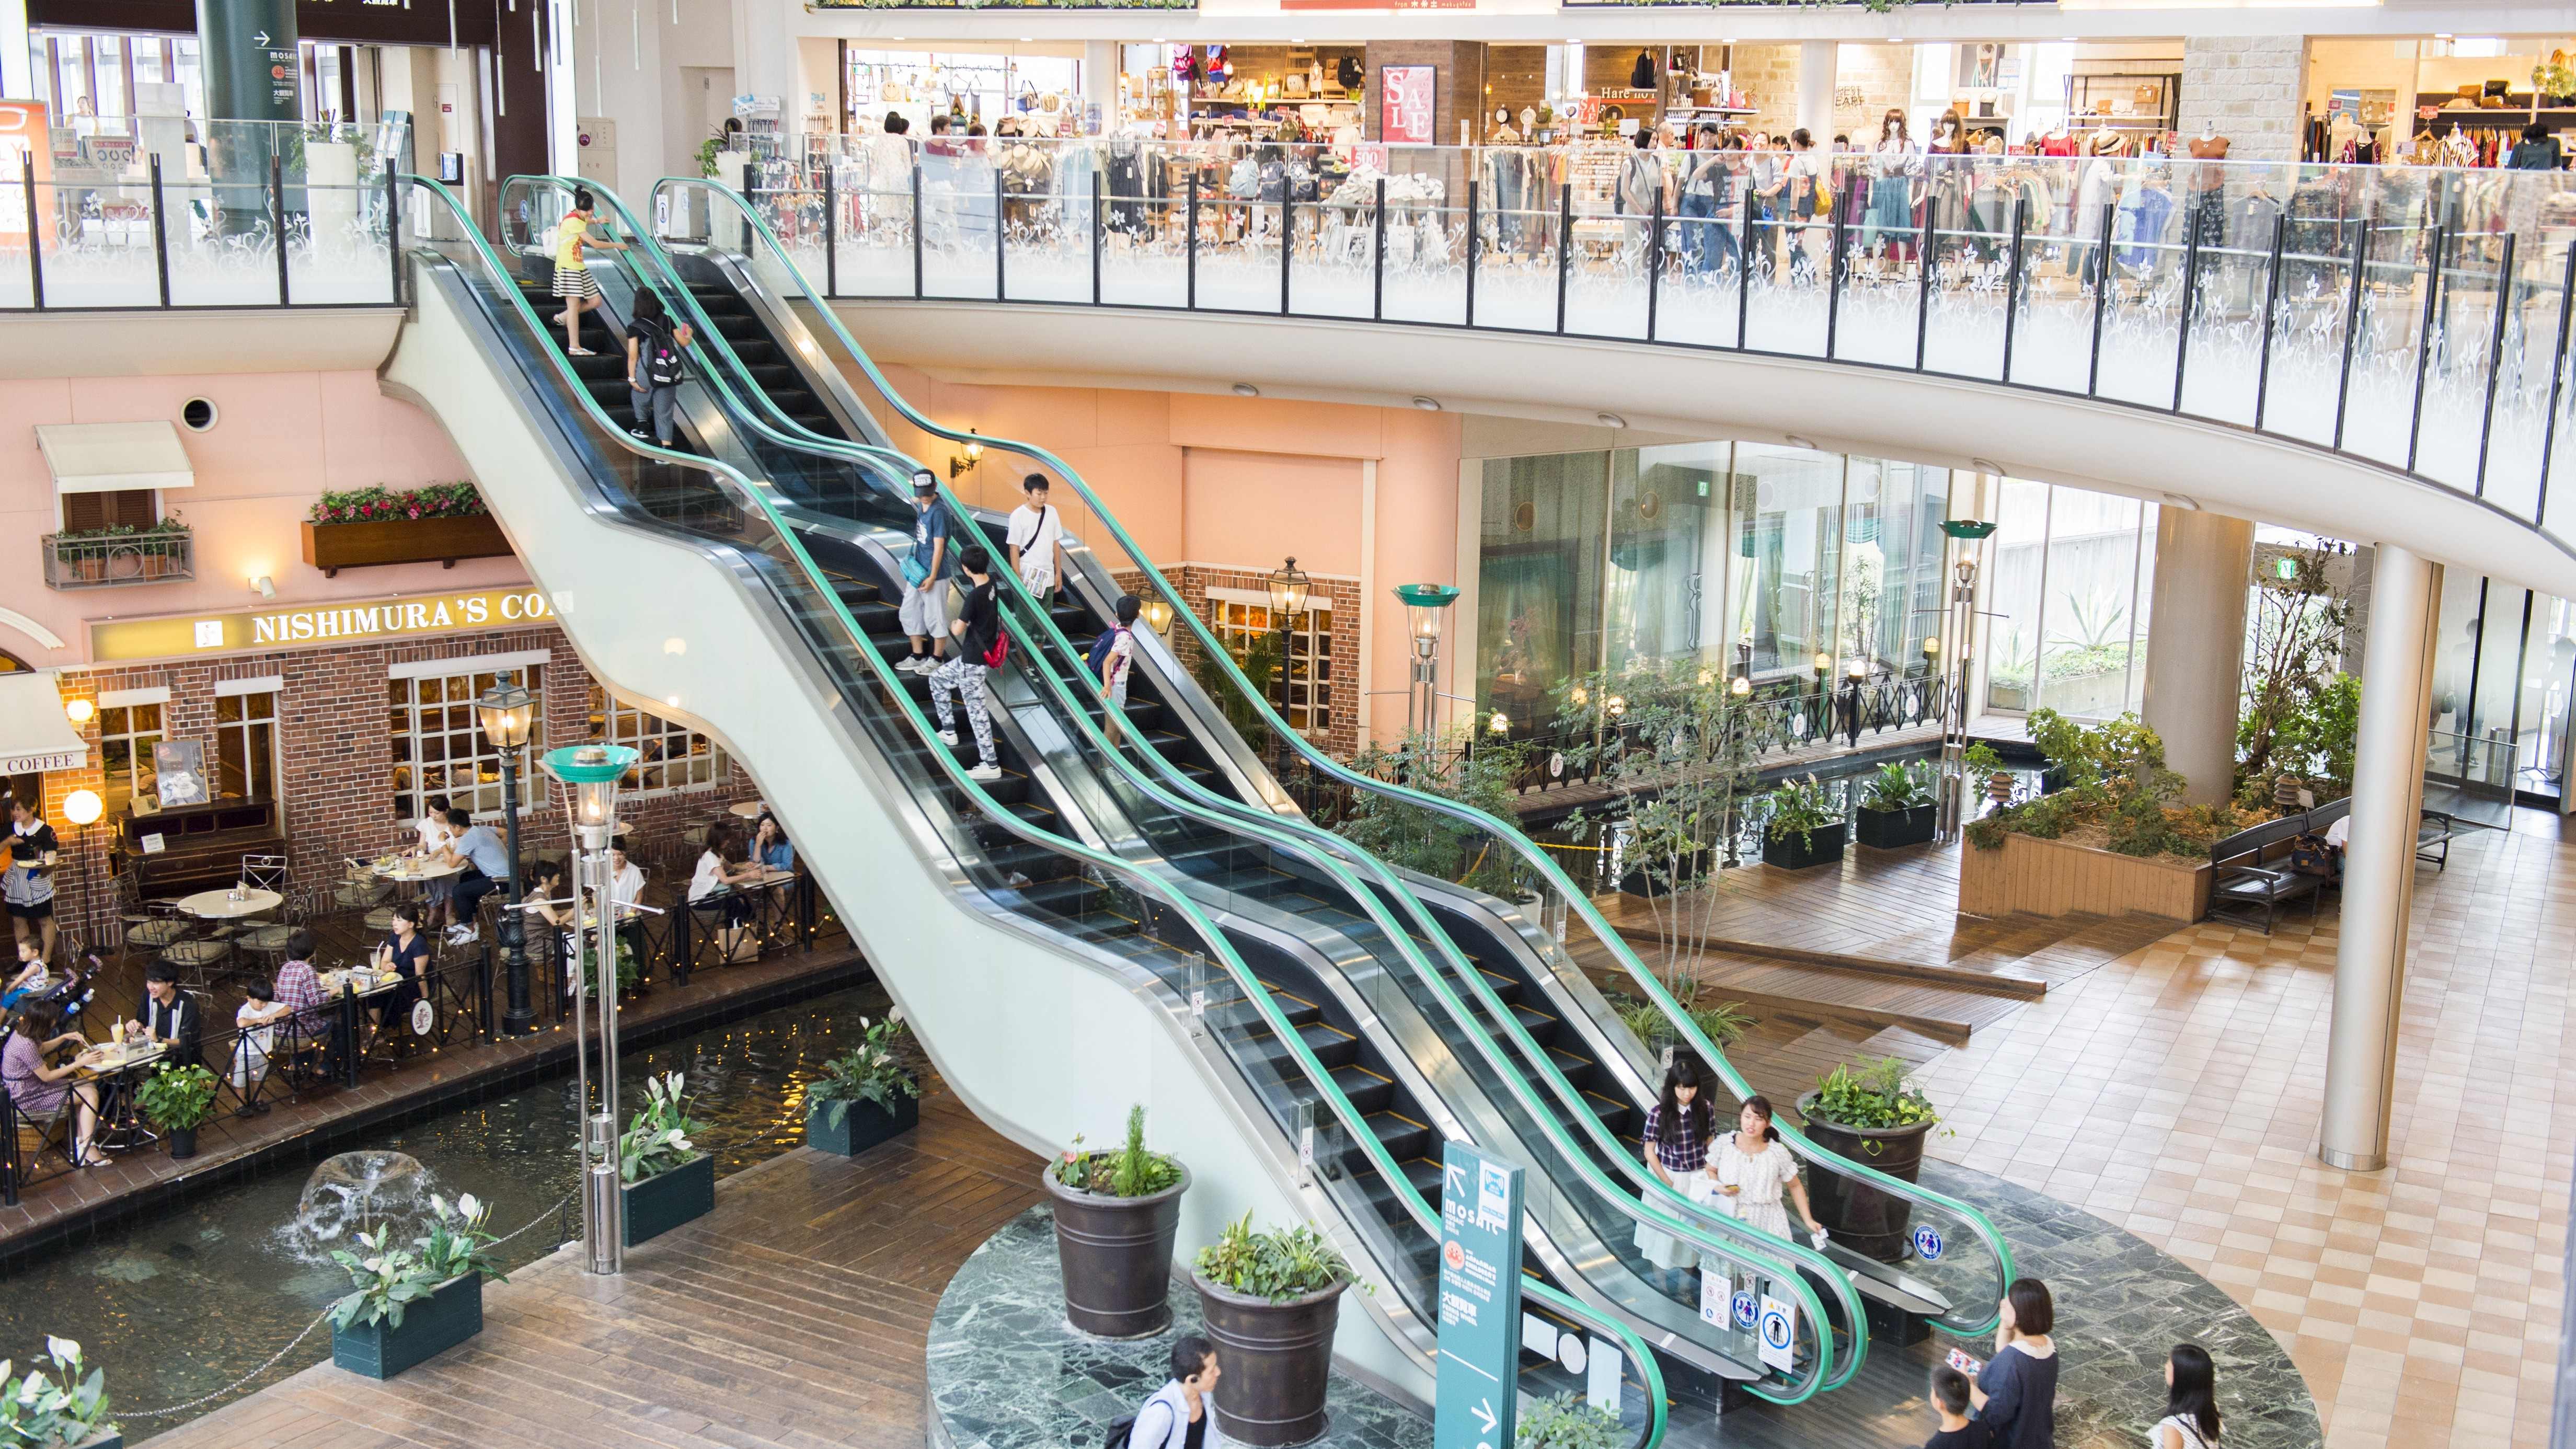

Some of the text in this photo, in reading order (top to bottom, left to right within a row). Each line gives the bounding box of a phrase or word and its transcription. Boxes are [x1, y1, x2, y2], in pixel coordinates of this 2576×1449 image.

[1386, 72, 1430, 138] SALE
[1601, 87, 1630, 99] Hare
[253, 594, 555, 643] NISHIMURA'S CO
[8, 754, 74, 772] COFFEE
